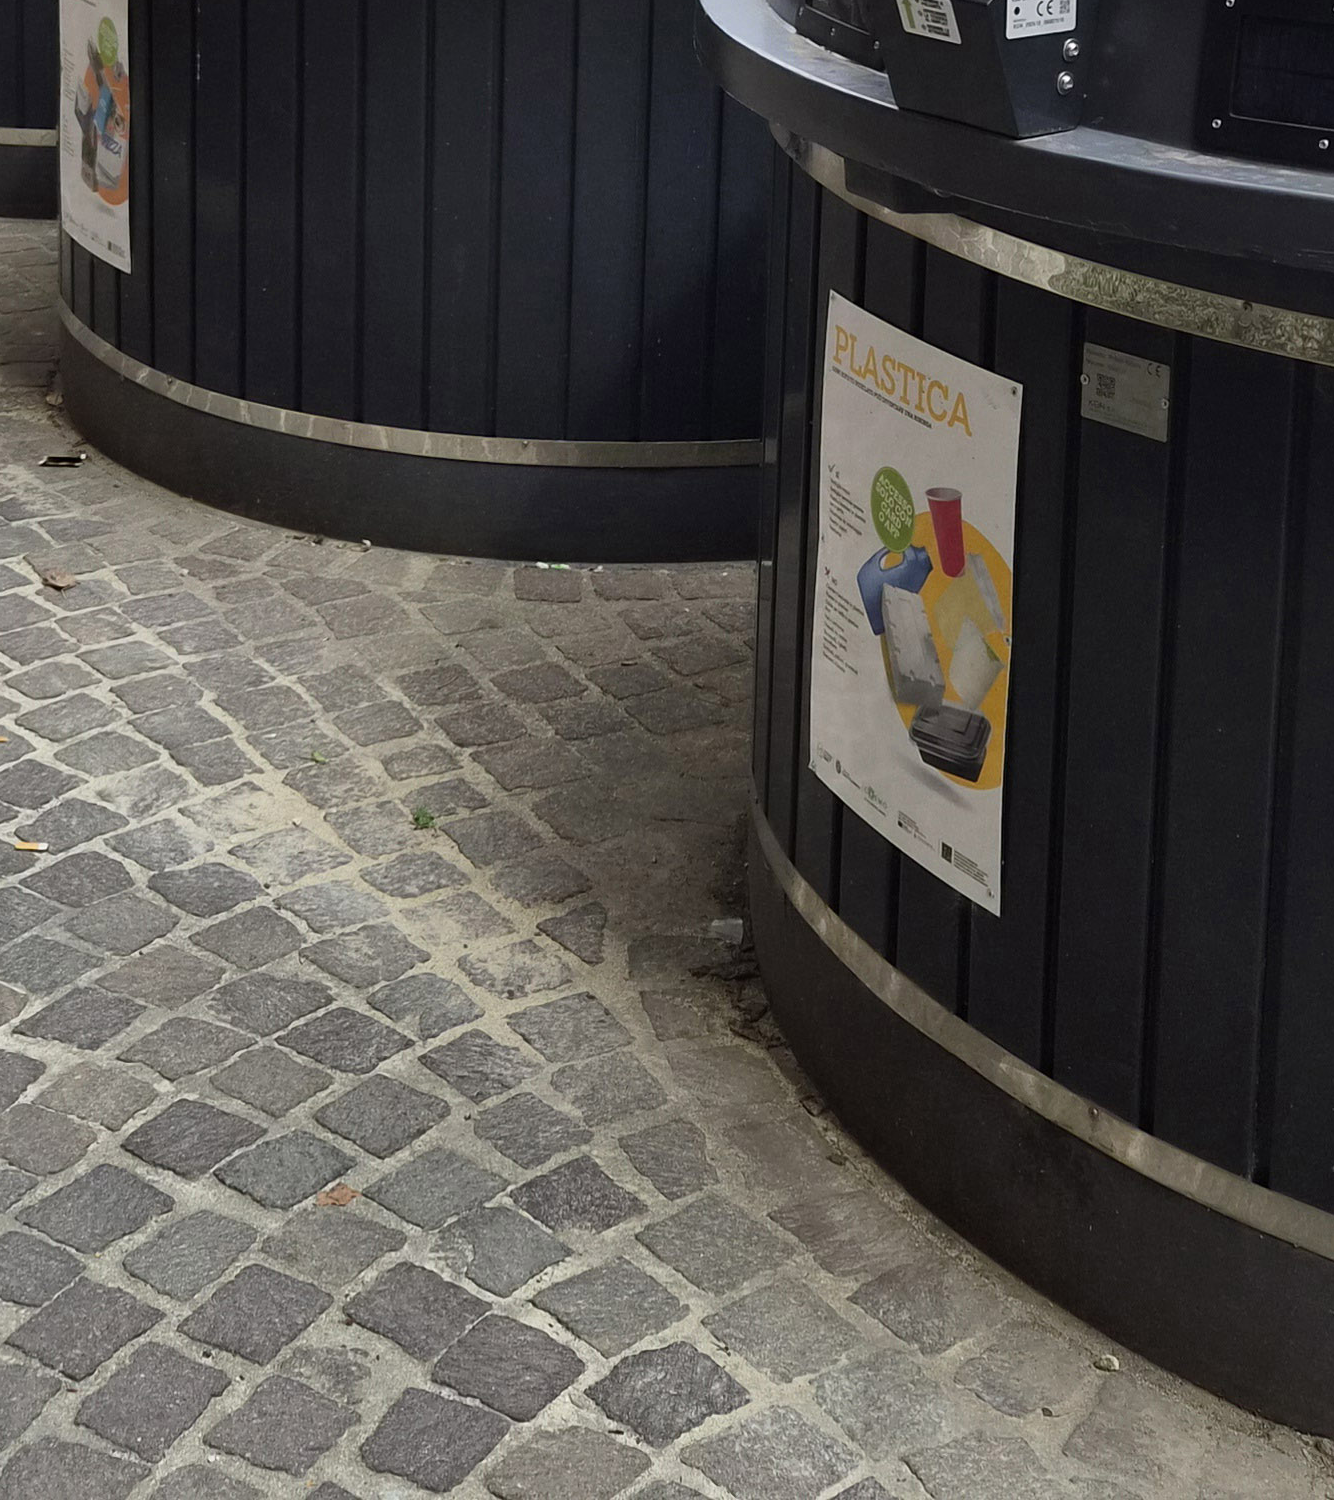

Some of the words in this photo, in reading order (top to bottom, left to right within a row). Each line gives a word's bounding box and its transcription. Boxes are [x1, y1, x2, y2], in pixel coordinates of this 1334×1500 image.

[832, 325, 973, 437] PLASTICA
[875, 481, 895, 508] SOLO
[895, 504, 912, 528] CON
[878, 474, 913, 516] ACCESSO
[881, 501, 902, 529] CARD
[884, 519, 900, 539] APP
